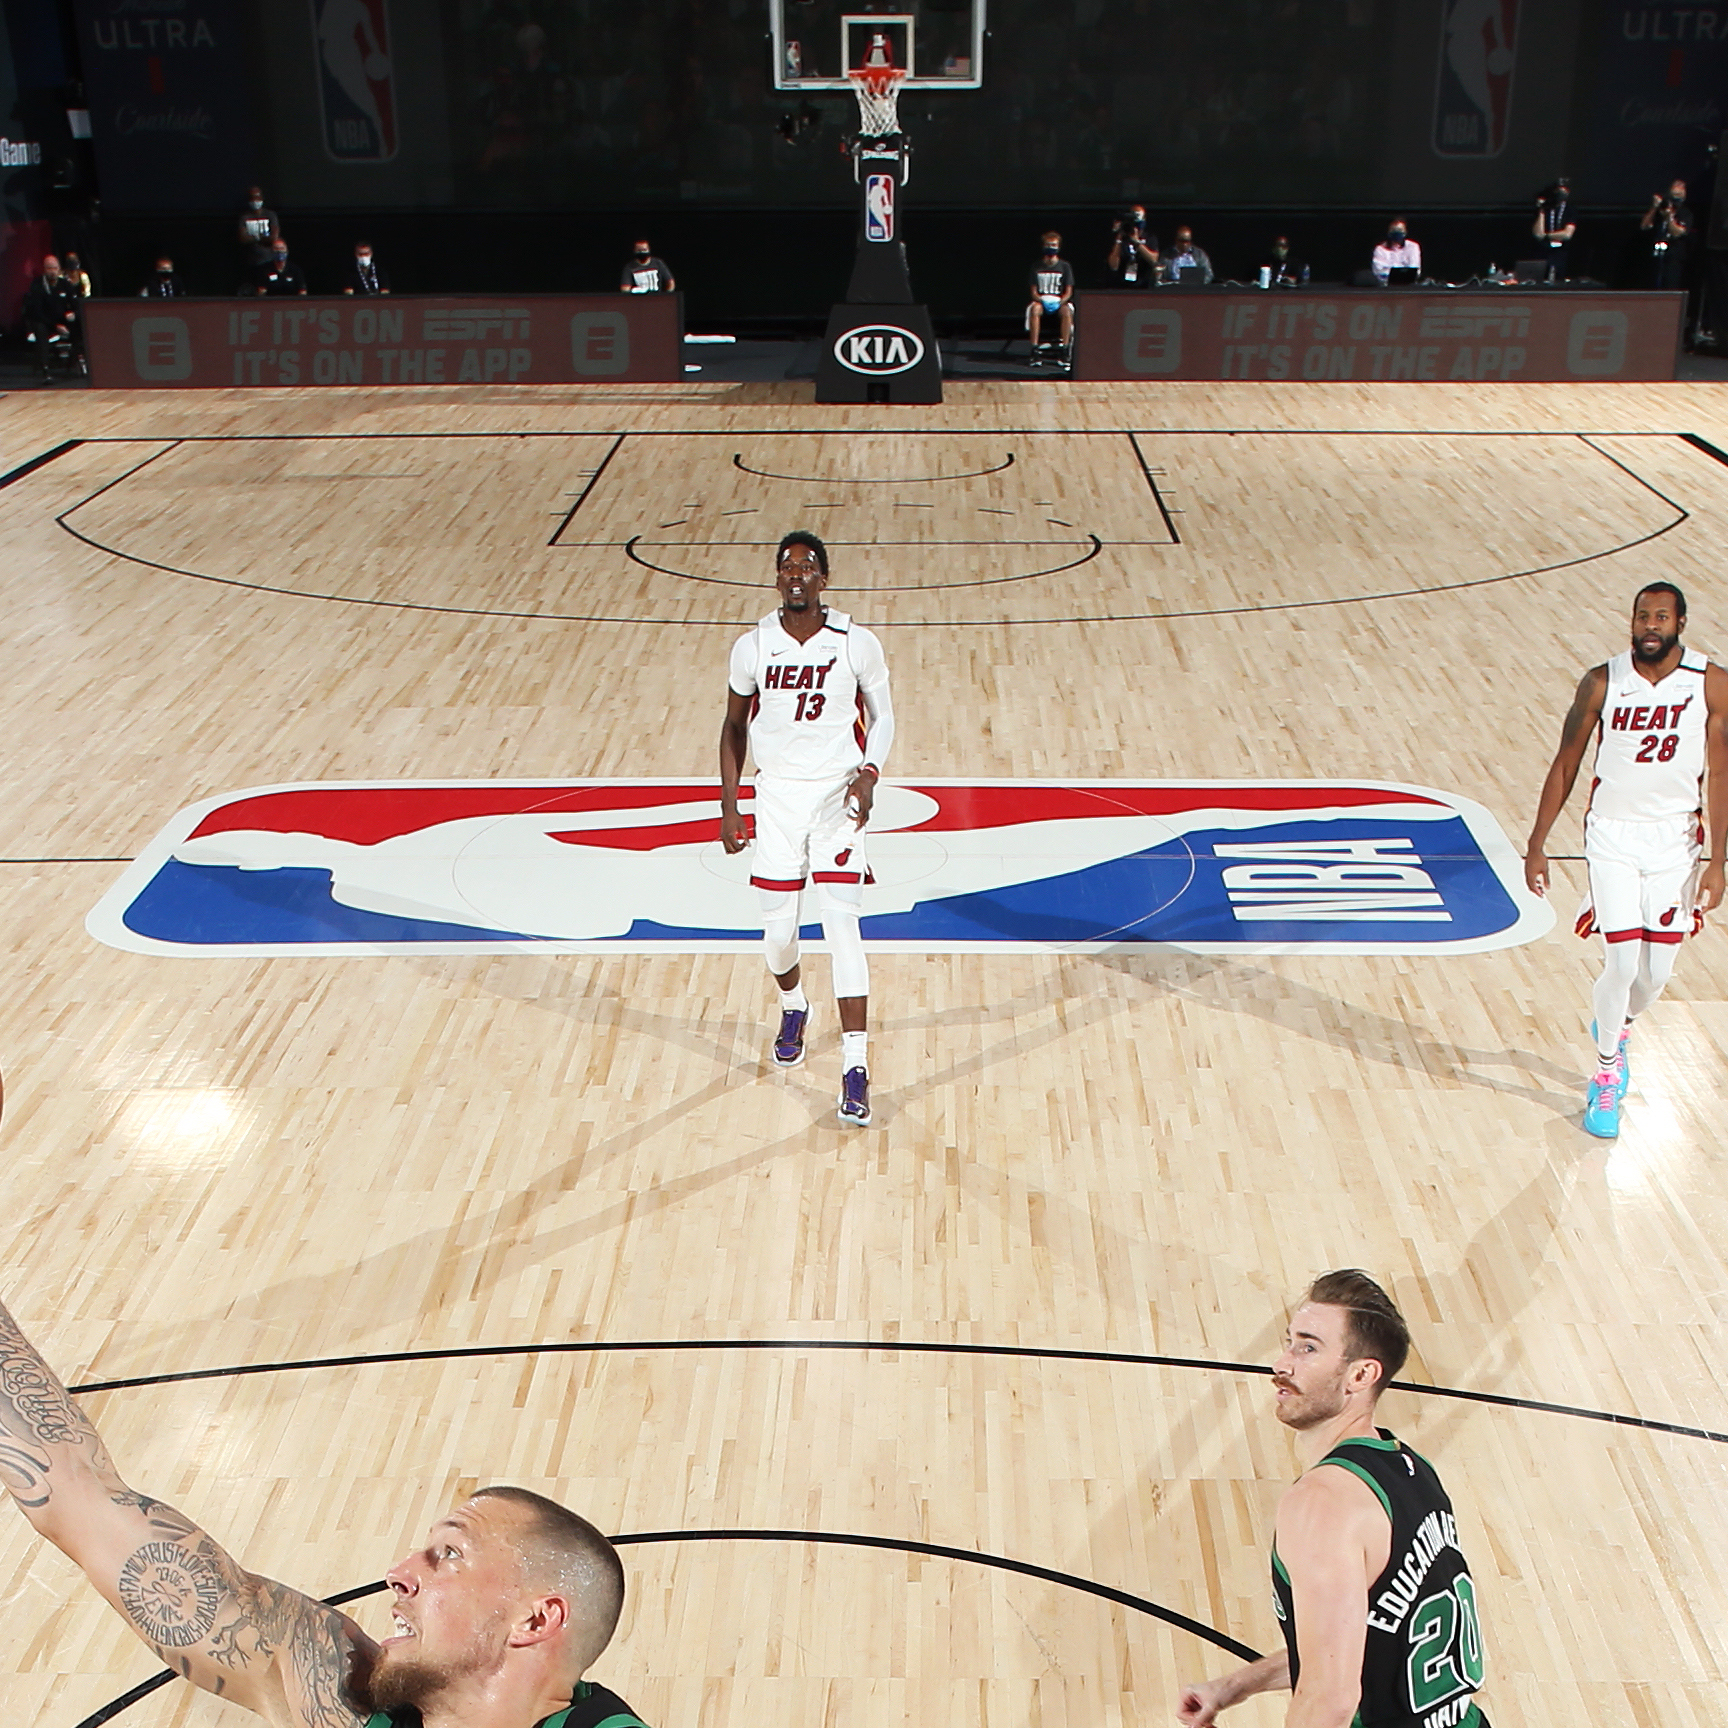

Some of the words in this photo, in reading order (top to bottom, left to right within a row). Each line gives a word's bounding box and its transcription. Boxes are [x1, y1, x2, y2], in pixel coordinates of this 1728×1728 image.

[93, 18, 215, 49] ULTRA
[334, 118, 370, 149] NBA
[228, 311, 261, 345] IF
[273, 308, 340, 345] IT'S
[353, 308, 404, 344] ON
[423, 308, 530, 340] ESPN
[1223, 305, 1257, 338] IF
[1266, 303, 1338, 340] IT'S
[1348, 305, 1403, 339] ON
[1421, 306, 1532, 338] ESPN
[234, 350, 301, 385] IT'S
[313, 350, 364, 385] ON
[377, 350, 446, 384] THE
[458, 348, 532, 382] APP
[849, 336, 909, 364] KIA
[1223, 345, 1292, 379] IT'S
[1302, 346, 1356, 380] ON
[1369, 346, 1440, 380] THE
[1449, 346, 1526, 380] APP
[765, 656, 838, 689] HEAT
[794, 692, 827, 722] 13
[1611, 693, 1693, 731] HEAT
[1635, 734, 1680, 763] 28
[1212, 837, 1453, 922] NBA
[1366, 1511, 1446, 1634] EDUCATION
[1407, 1572, 1485, 1714] 20
